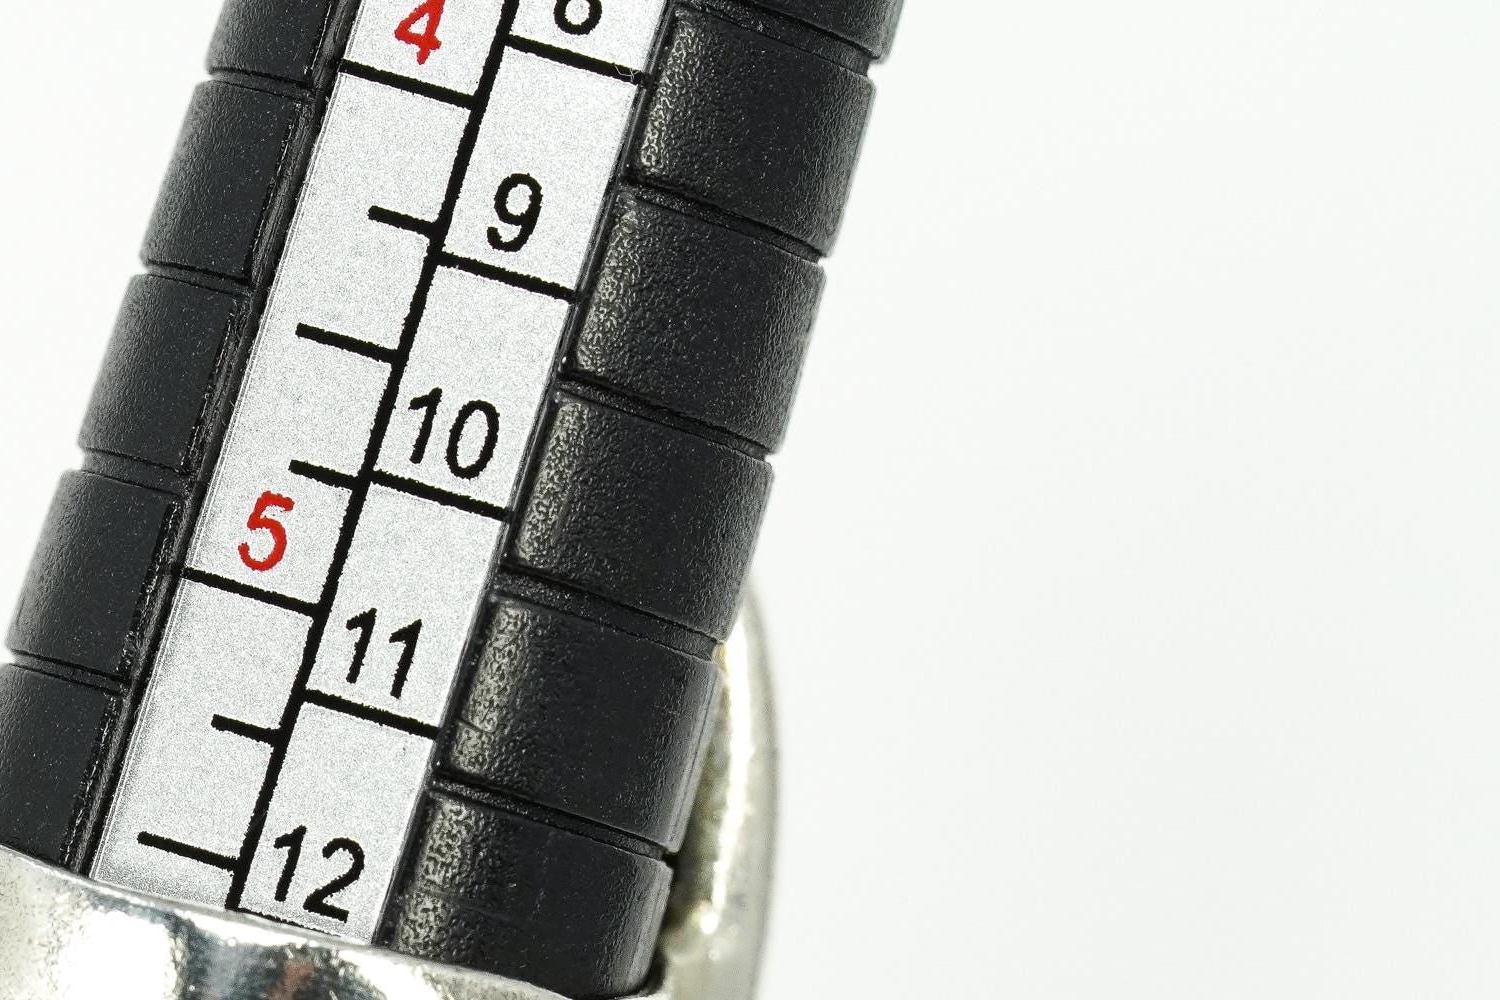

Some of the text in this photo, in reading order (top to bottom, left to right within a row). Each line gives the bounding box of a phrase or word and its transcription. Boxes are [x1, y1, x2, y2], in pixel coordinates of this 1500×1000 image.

[394, 0, 445, 65] 4
[486, 172, 544, 253] 9
[407, 386, 501, 481] 10
[238, 491, 294, 572] 5
[345, 607, 423, 700] 11
[273, 824, 366, 922] 12
